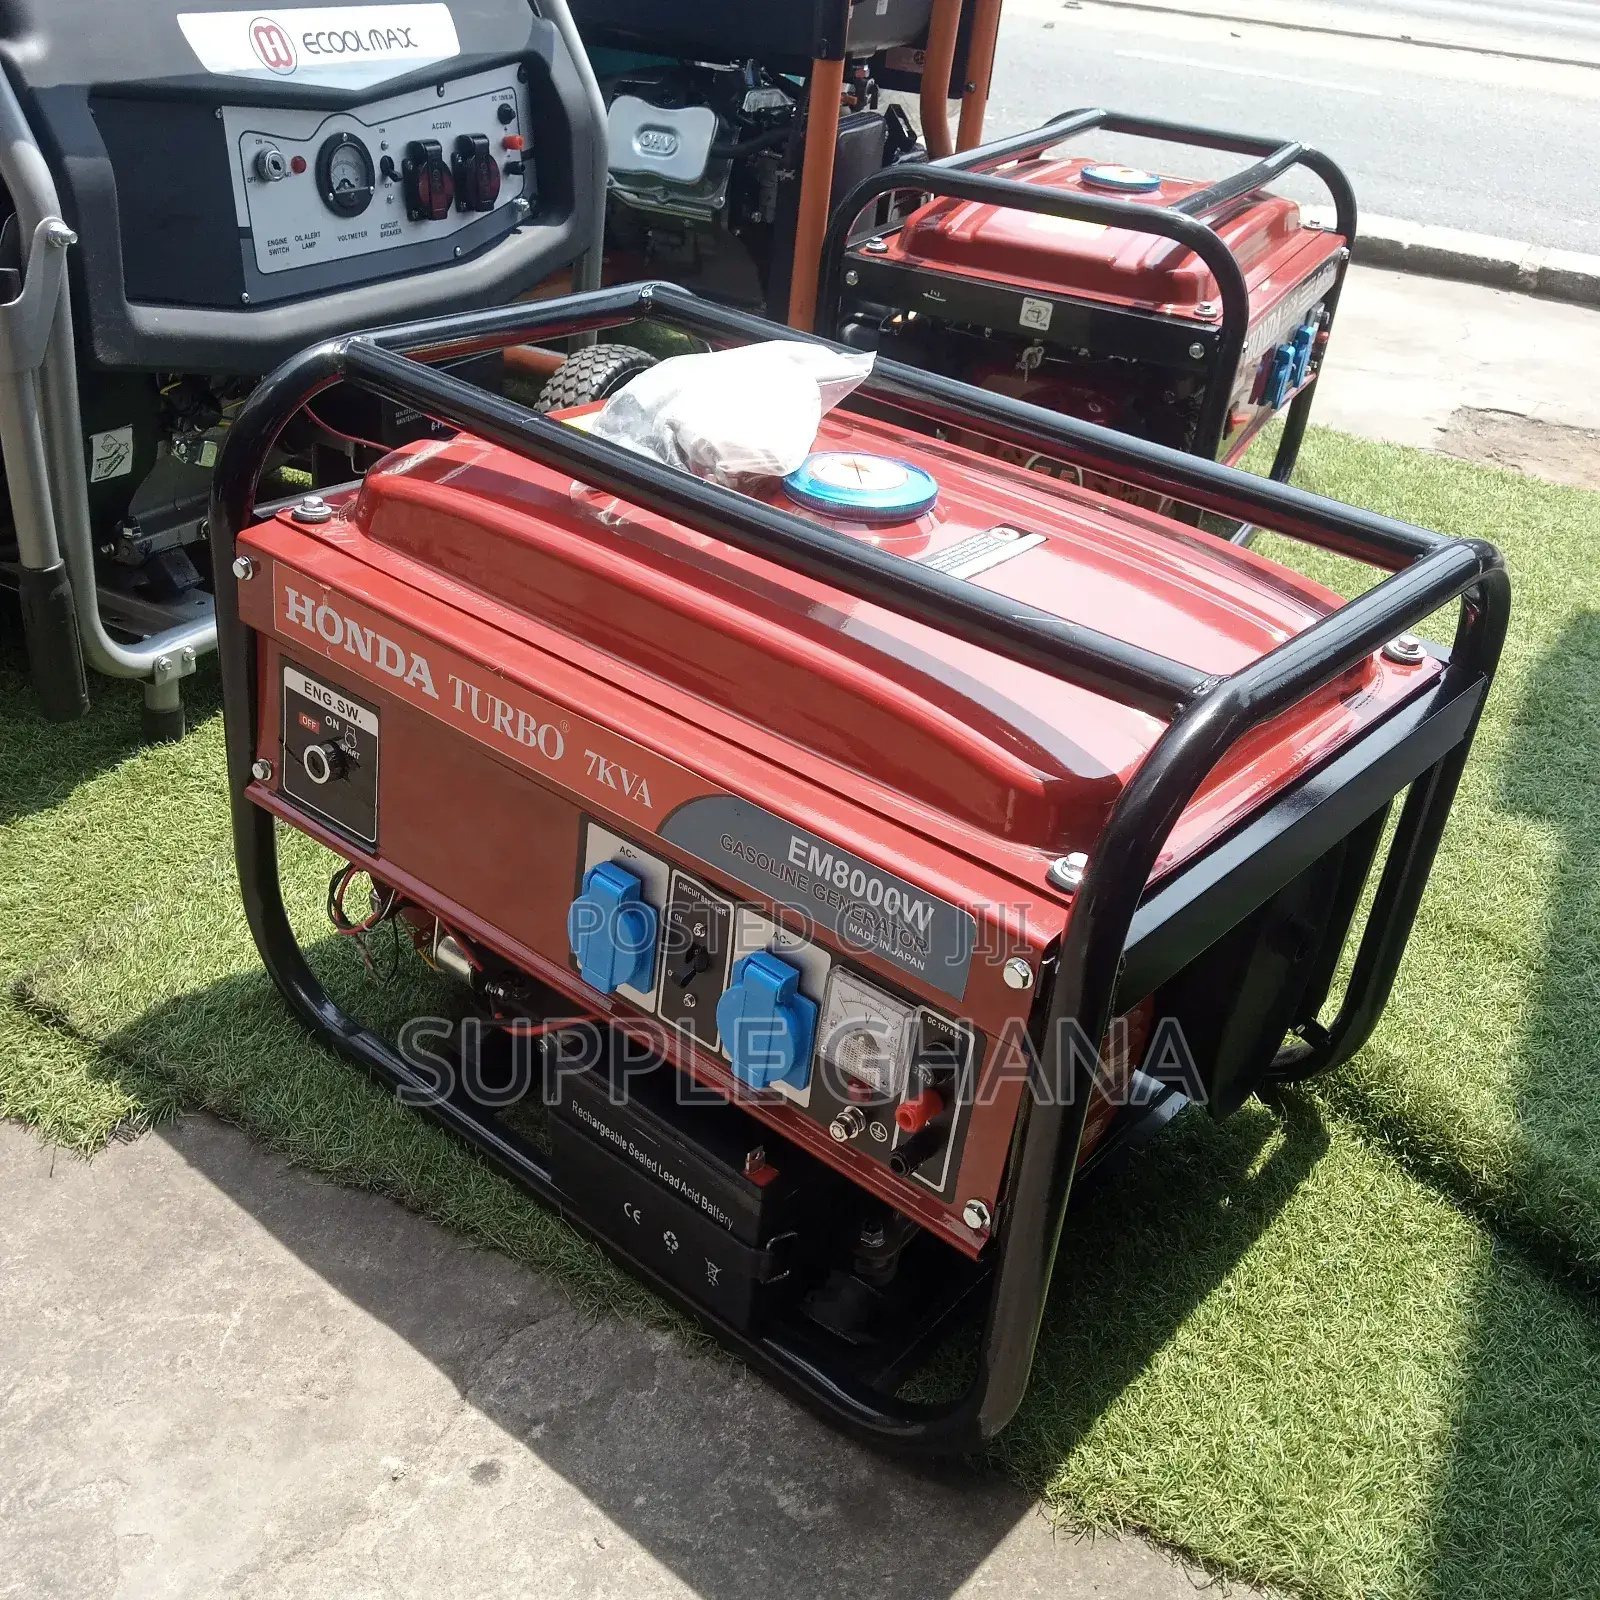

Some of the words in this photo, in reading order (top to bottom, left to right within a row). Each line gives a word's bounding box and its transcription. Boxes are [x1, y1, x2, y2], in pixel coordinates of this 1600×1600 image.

[302, 27, 418, 54] ECOOLMAX
[431, 121, 452, 131] AC220V
[380, 221, 399, 230] CIRCUIT
[380, 228, 402, 238] BREAKER
[267, 237, 288, 247] ENGINE
[304, 231, 321, 240] ALERT
[337, 230, 368, 242] VOLTMETER
[268, 246, 290, 256] SWITCH
[301, 241, 317, 250] LAMP
[284, 585, 440, 700] HONDA
[582, 748, 654, 809] 7KVA
[302, 715, 317, 730] OFF
[325, 715, 340, 731] ON
[340, 743, 361, 760] START
[787, 834, 936, 932] EM8000W
[678, 881, 701, 900] CIRCUIT
[700, 895, 727, 917] BREAKER
[719, 832, 810, 894] GASOLINE
[811, 882, 930, 957] GENERATOR
[848, 922, 879, 947] MADE
[879, 937, 890, 952] IN
[891, 943, 926, 971] JAPAN
[927, 1016, 937, 1027] DC
[937, 1022, 950, 1034] 12V
[571, 1099, 628, 1151] Rechargeable
[628, 1142, 658, 1173] Sealed
[658, 1163, 680, 1189] Lead
[680, 1181, 700, 1204] Acid
[701, 1196, 734, 1231] Battery
